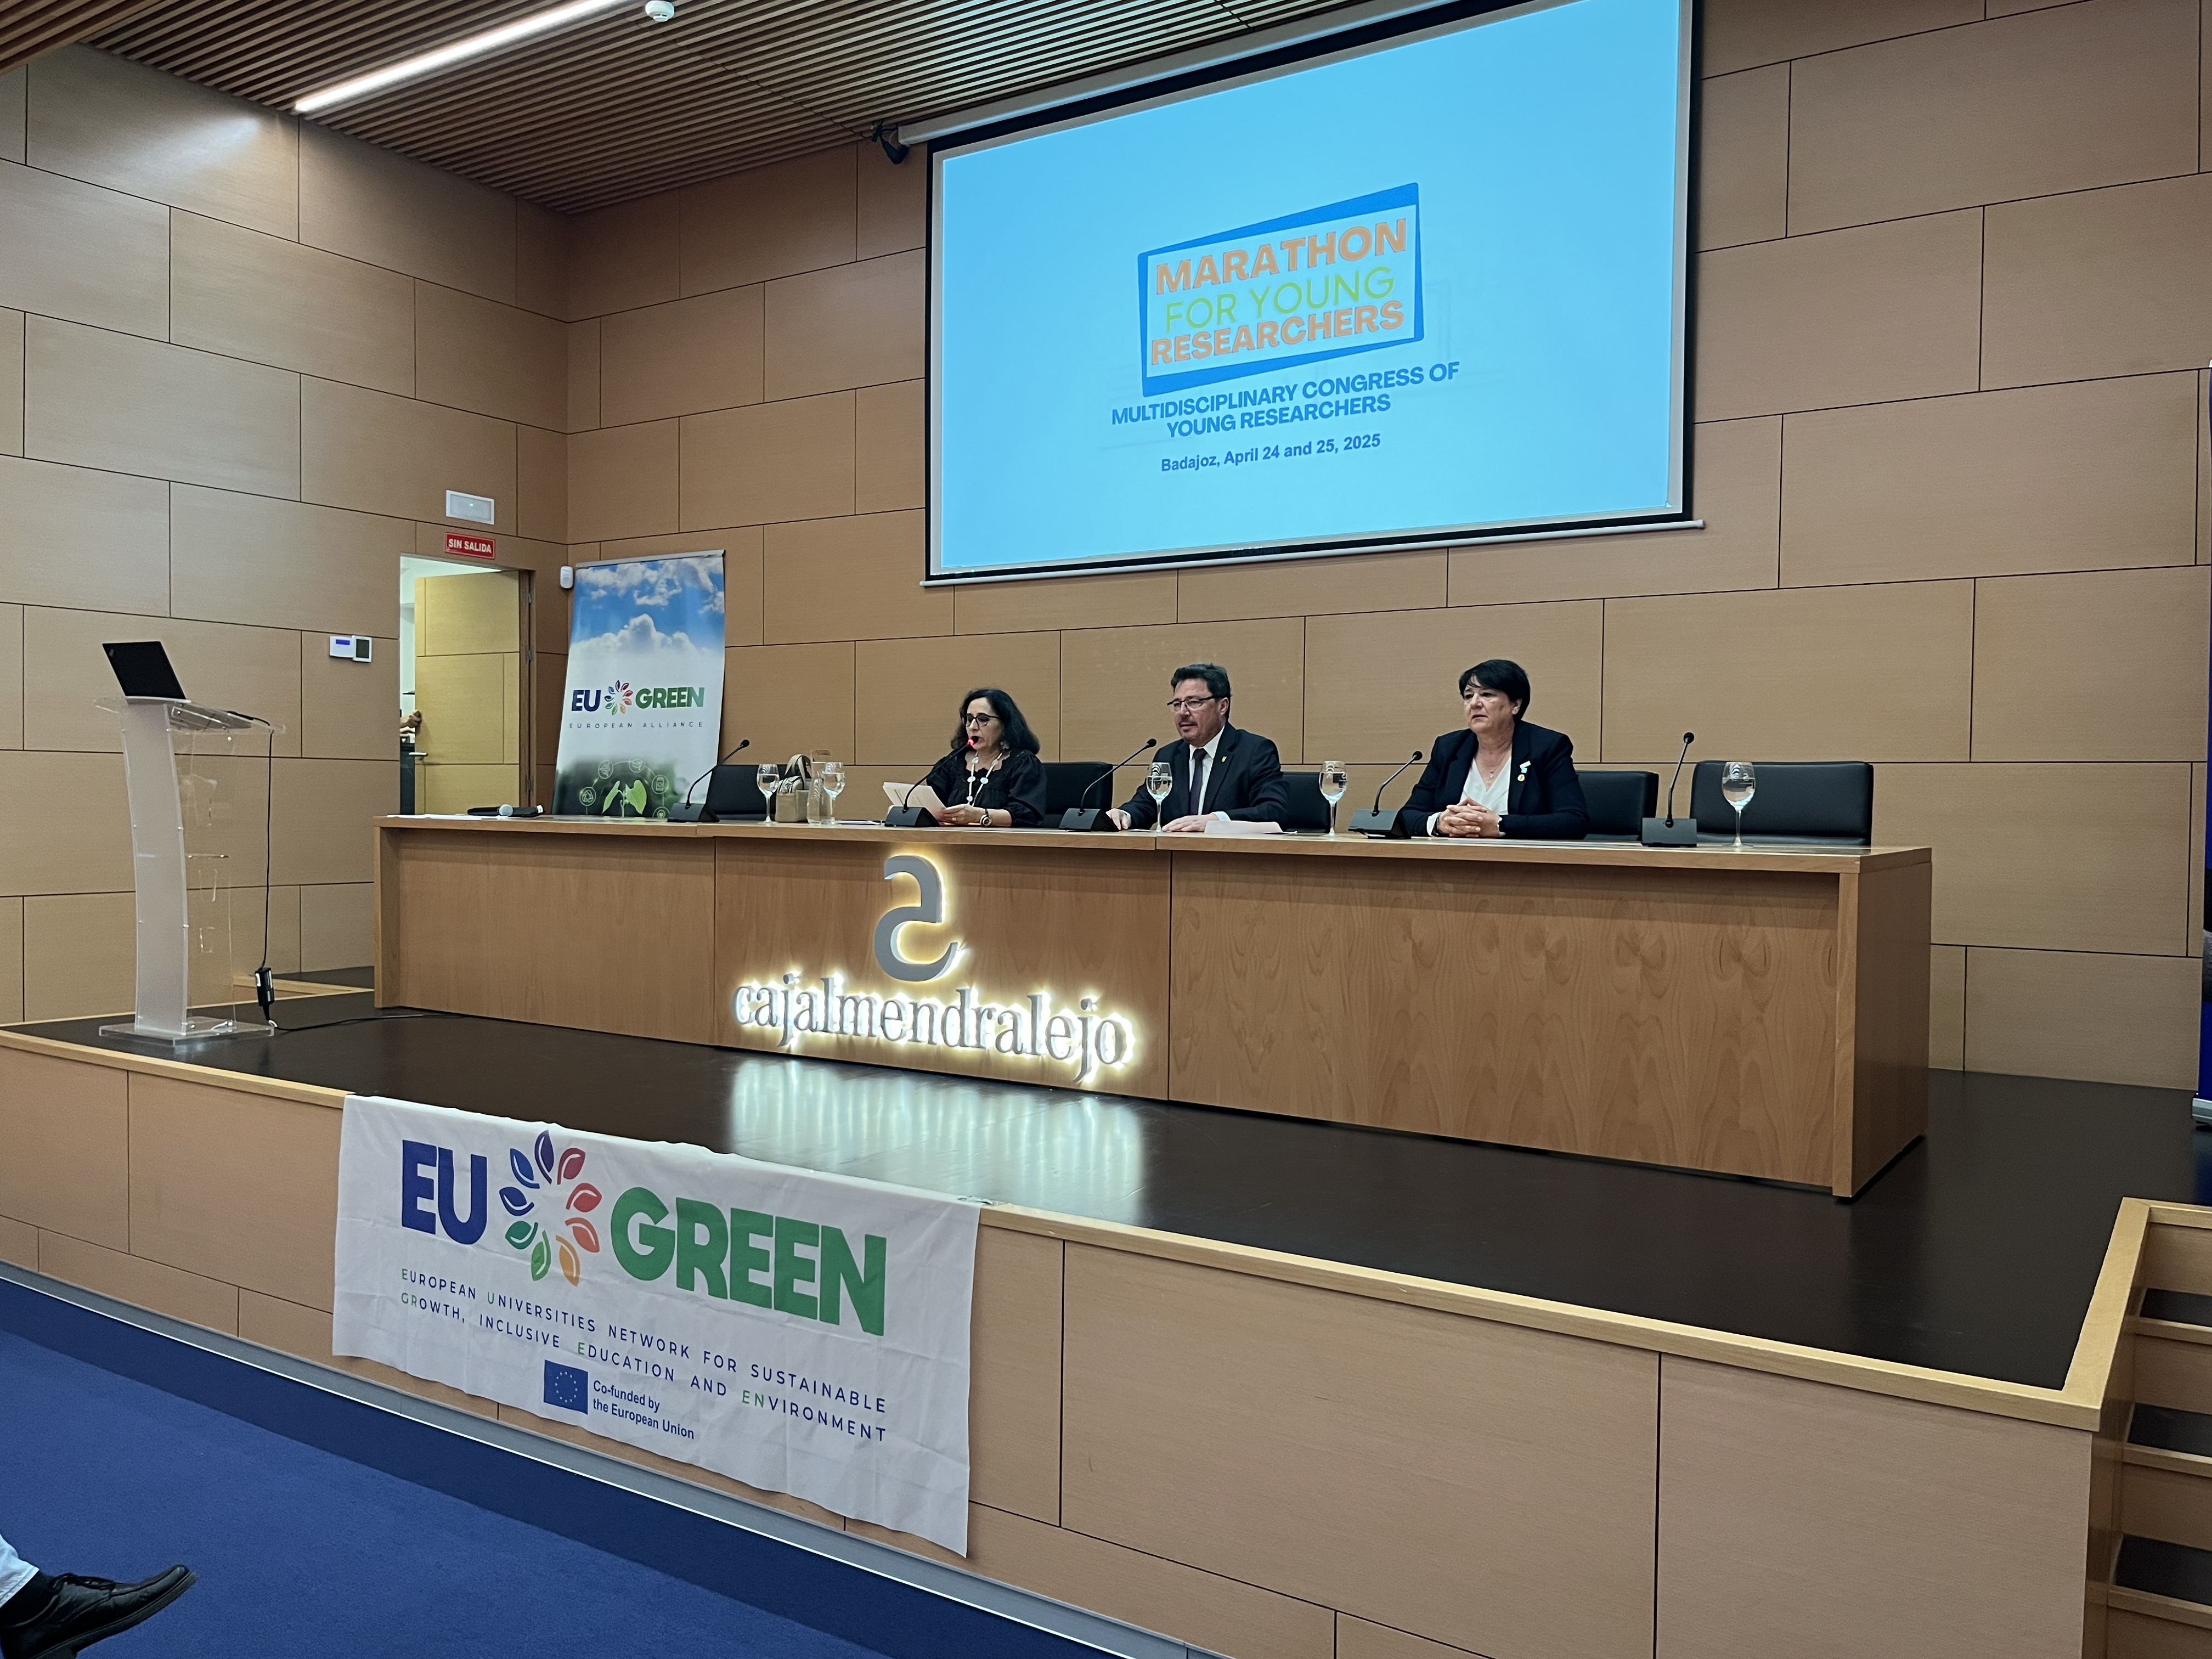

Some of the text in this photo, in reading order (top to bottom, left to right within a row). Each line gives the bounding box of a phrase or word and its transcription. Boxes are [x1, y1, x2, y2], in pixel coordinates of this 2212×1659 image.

[1156, 218, 1407, 295] MARATHON
[1166, 266, 1395, 334] FOR YOUNG
[1152, 300, 1405, 365] RESEARCHERS
[1111, 362, 1459, 425] MULTIDISCIPLINARY CONGRESS OF
[1167, 394, 1391, 438] YOUNG RESEARCHERS
[1161, 433, 1381, 471] Badajoz, April 24 and 25, 2025
[448, 538, 492, 554] SIN SALIDA
[571, 687, 705, 712] EU GREEN
[732, 973, 1128, 1083] cajalmendralejo
[401, 1139, 887, 1337] EU GREEN
[401, 1292, 886, 1442] GROWTH, INCLUSIVE EDUCATION AND ENVIRONMENT
[402, 1268, 885, 1413] EUROPEAN UNIVERSITIES NETWORK FOR SUSTAINABLE
[593, 1380, 660, 1413] Co-funded by
[593, 1398, 695, 1440] the European Union
